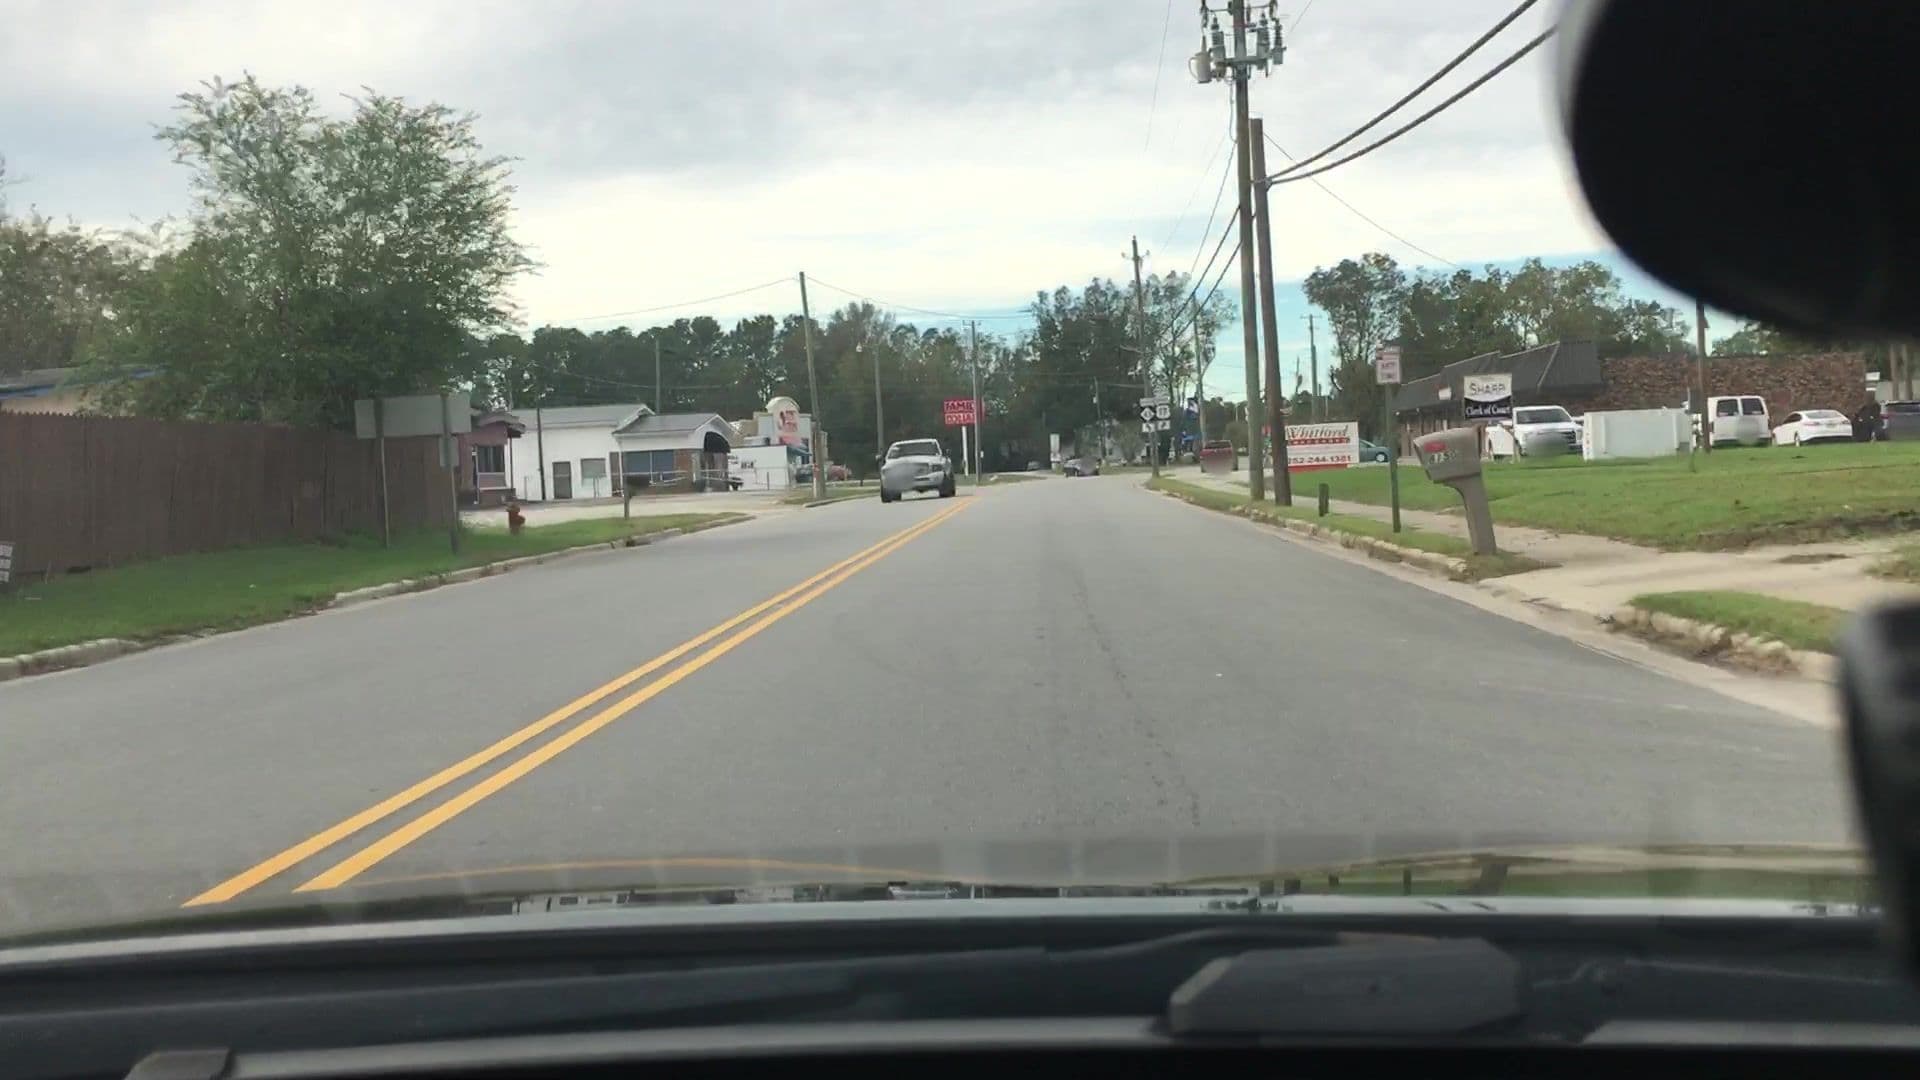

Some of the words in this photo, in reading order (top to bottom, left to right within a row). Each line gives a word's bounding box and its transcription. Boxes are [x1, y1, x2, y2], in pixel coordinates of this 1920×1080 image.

[1470, 382, 1506, 394] SHARP
[1465, 404, 1484, 416] Clerk
[1484, 404, 1491, 415] of
[1491, 403, 1511, 415] Court
